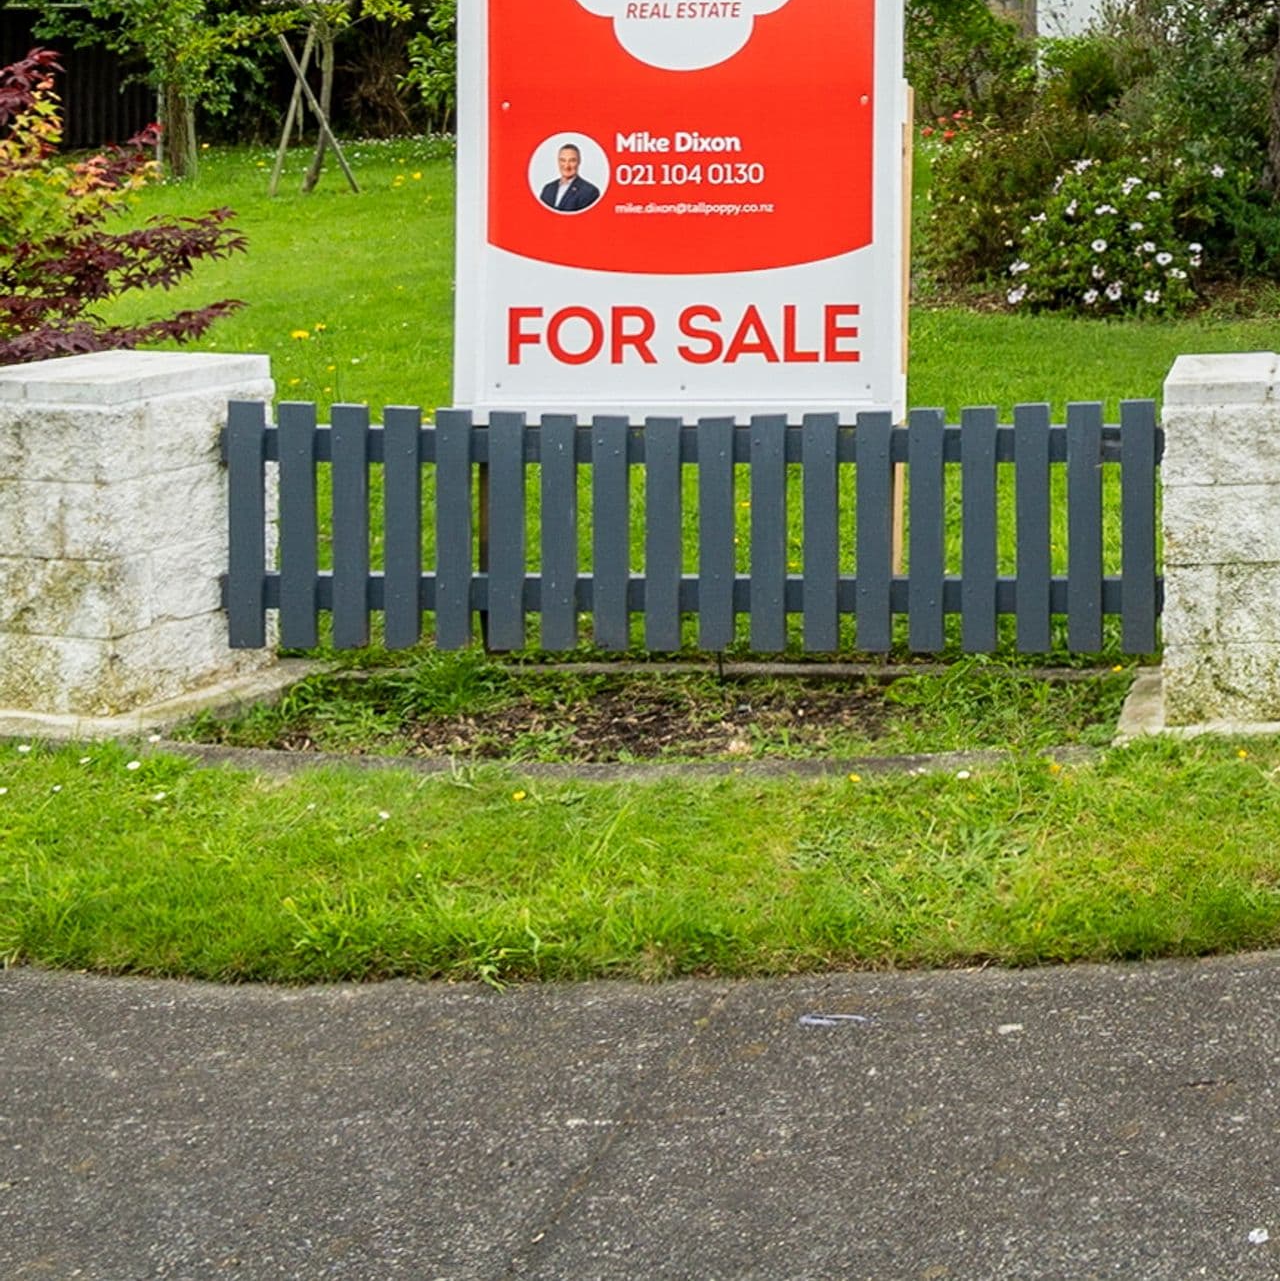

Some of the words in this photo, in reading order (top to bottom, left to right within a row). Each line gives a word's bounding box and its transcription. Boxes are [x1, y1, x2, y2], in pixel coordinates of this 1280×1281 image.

[626, 2, 671, 19] REAL
[676, 1, 742, 18] ESTATE
[615, 131, 670, 153] Mike
[674, 131, 742, 153] Dixon
[615, 164, 656, 186] 021
[660, 163, 702, 185] 104
[707, 162, 765, 185] 0130
[614, 202, 774, 216] mike.dixon@tallpoppy.co.nz
[507, 306, 658, 365] FOR
[677, 304, 861, 364] SALE
